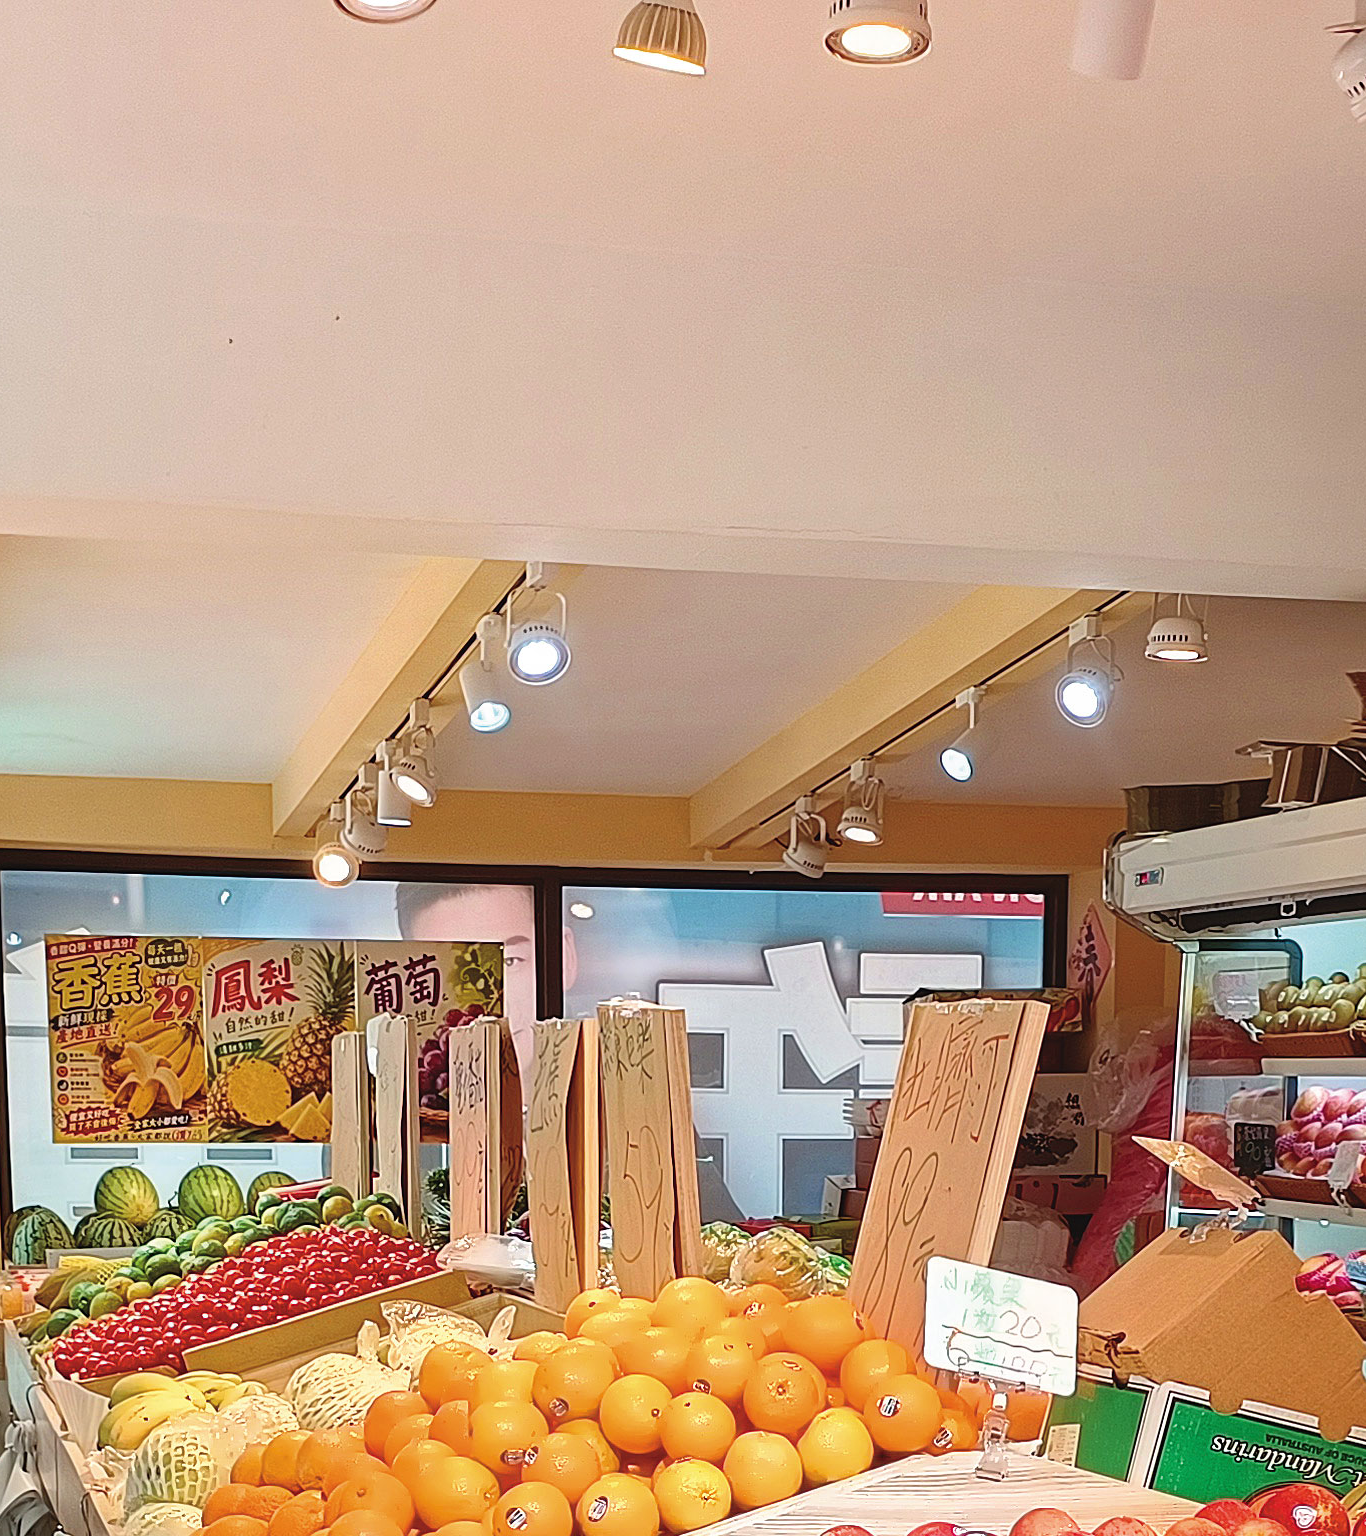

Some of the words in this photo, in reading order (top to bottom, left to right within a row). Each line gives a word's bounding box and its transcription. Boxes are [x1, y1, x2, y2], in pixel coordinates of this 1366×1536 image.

[52, 951, 145, 1011] 香蕉
[211, 957, 300, 1019] 鳳梨
[364, 954, 441, 1014] 葡萄
[153, 985, 195, 1021] 29
[225, 1007, 295, 1034] 自然的甜!
[57, 1023, 120, 1044] 產地直送!
[1211, 1434, 1349, 1485] Mandarins
[1266, 1434, 1324, 1457] AUSTRALIA
